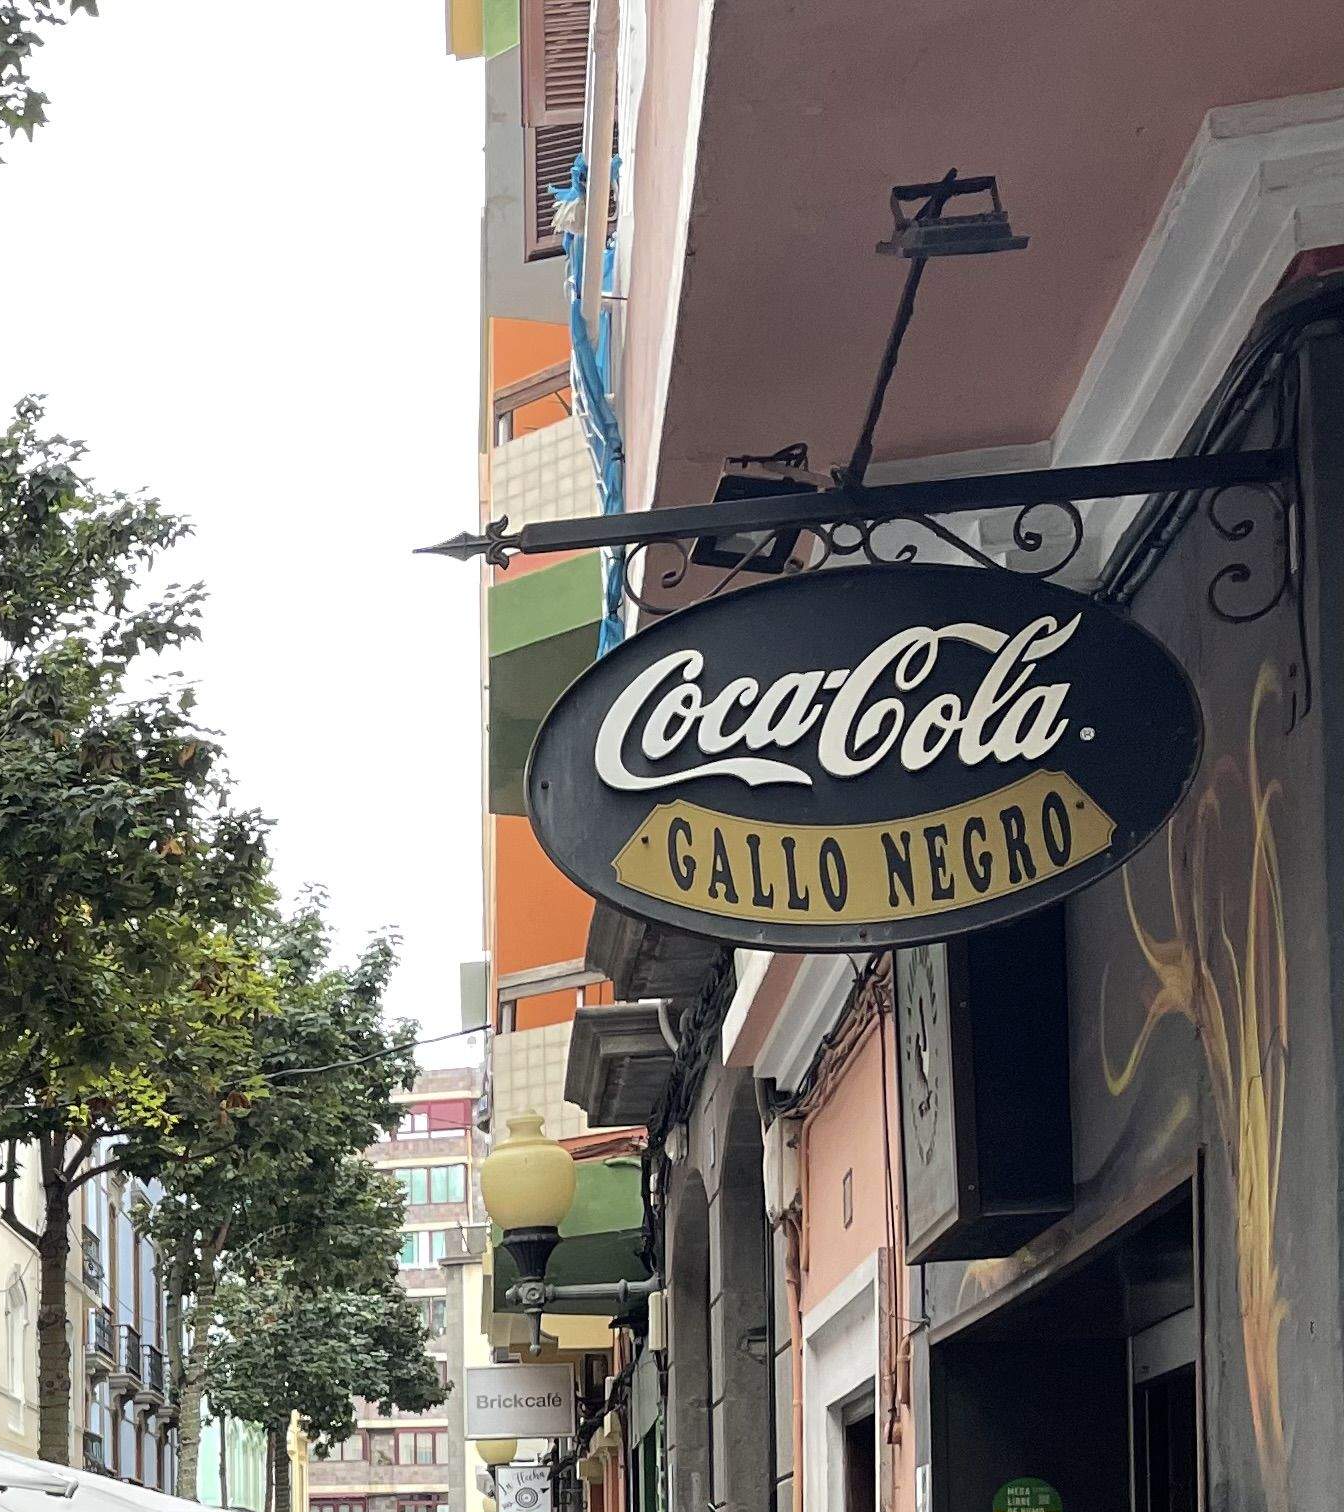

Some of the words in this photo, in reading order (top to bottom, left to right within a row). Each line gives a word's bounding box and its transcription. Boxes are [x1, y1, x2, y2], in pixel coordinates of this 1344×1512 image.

[594, 612, 1082, 791] Coca-Cola
[668, 816, 848, 913] GALLO
[880, 790, 1073, 908] NEGRO
